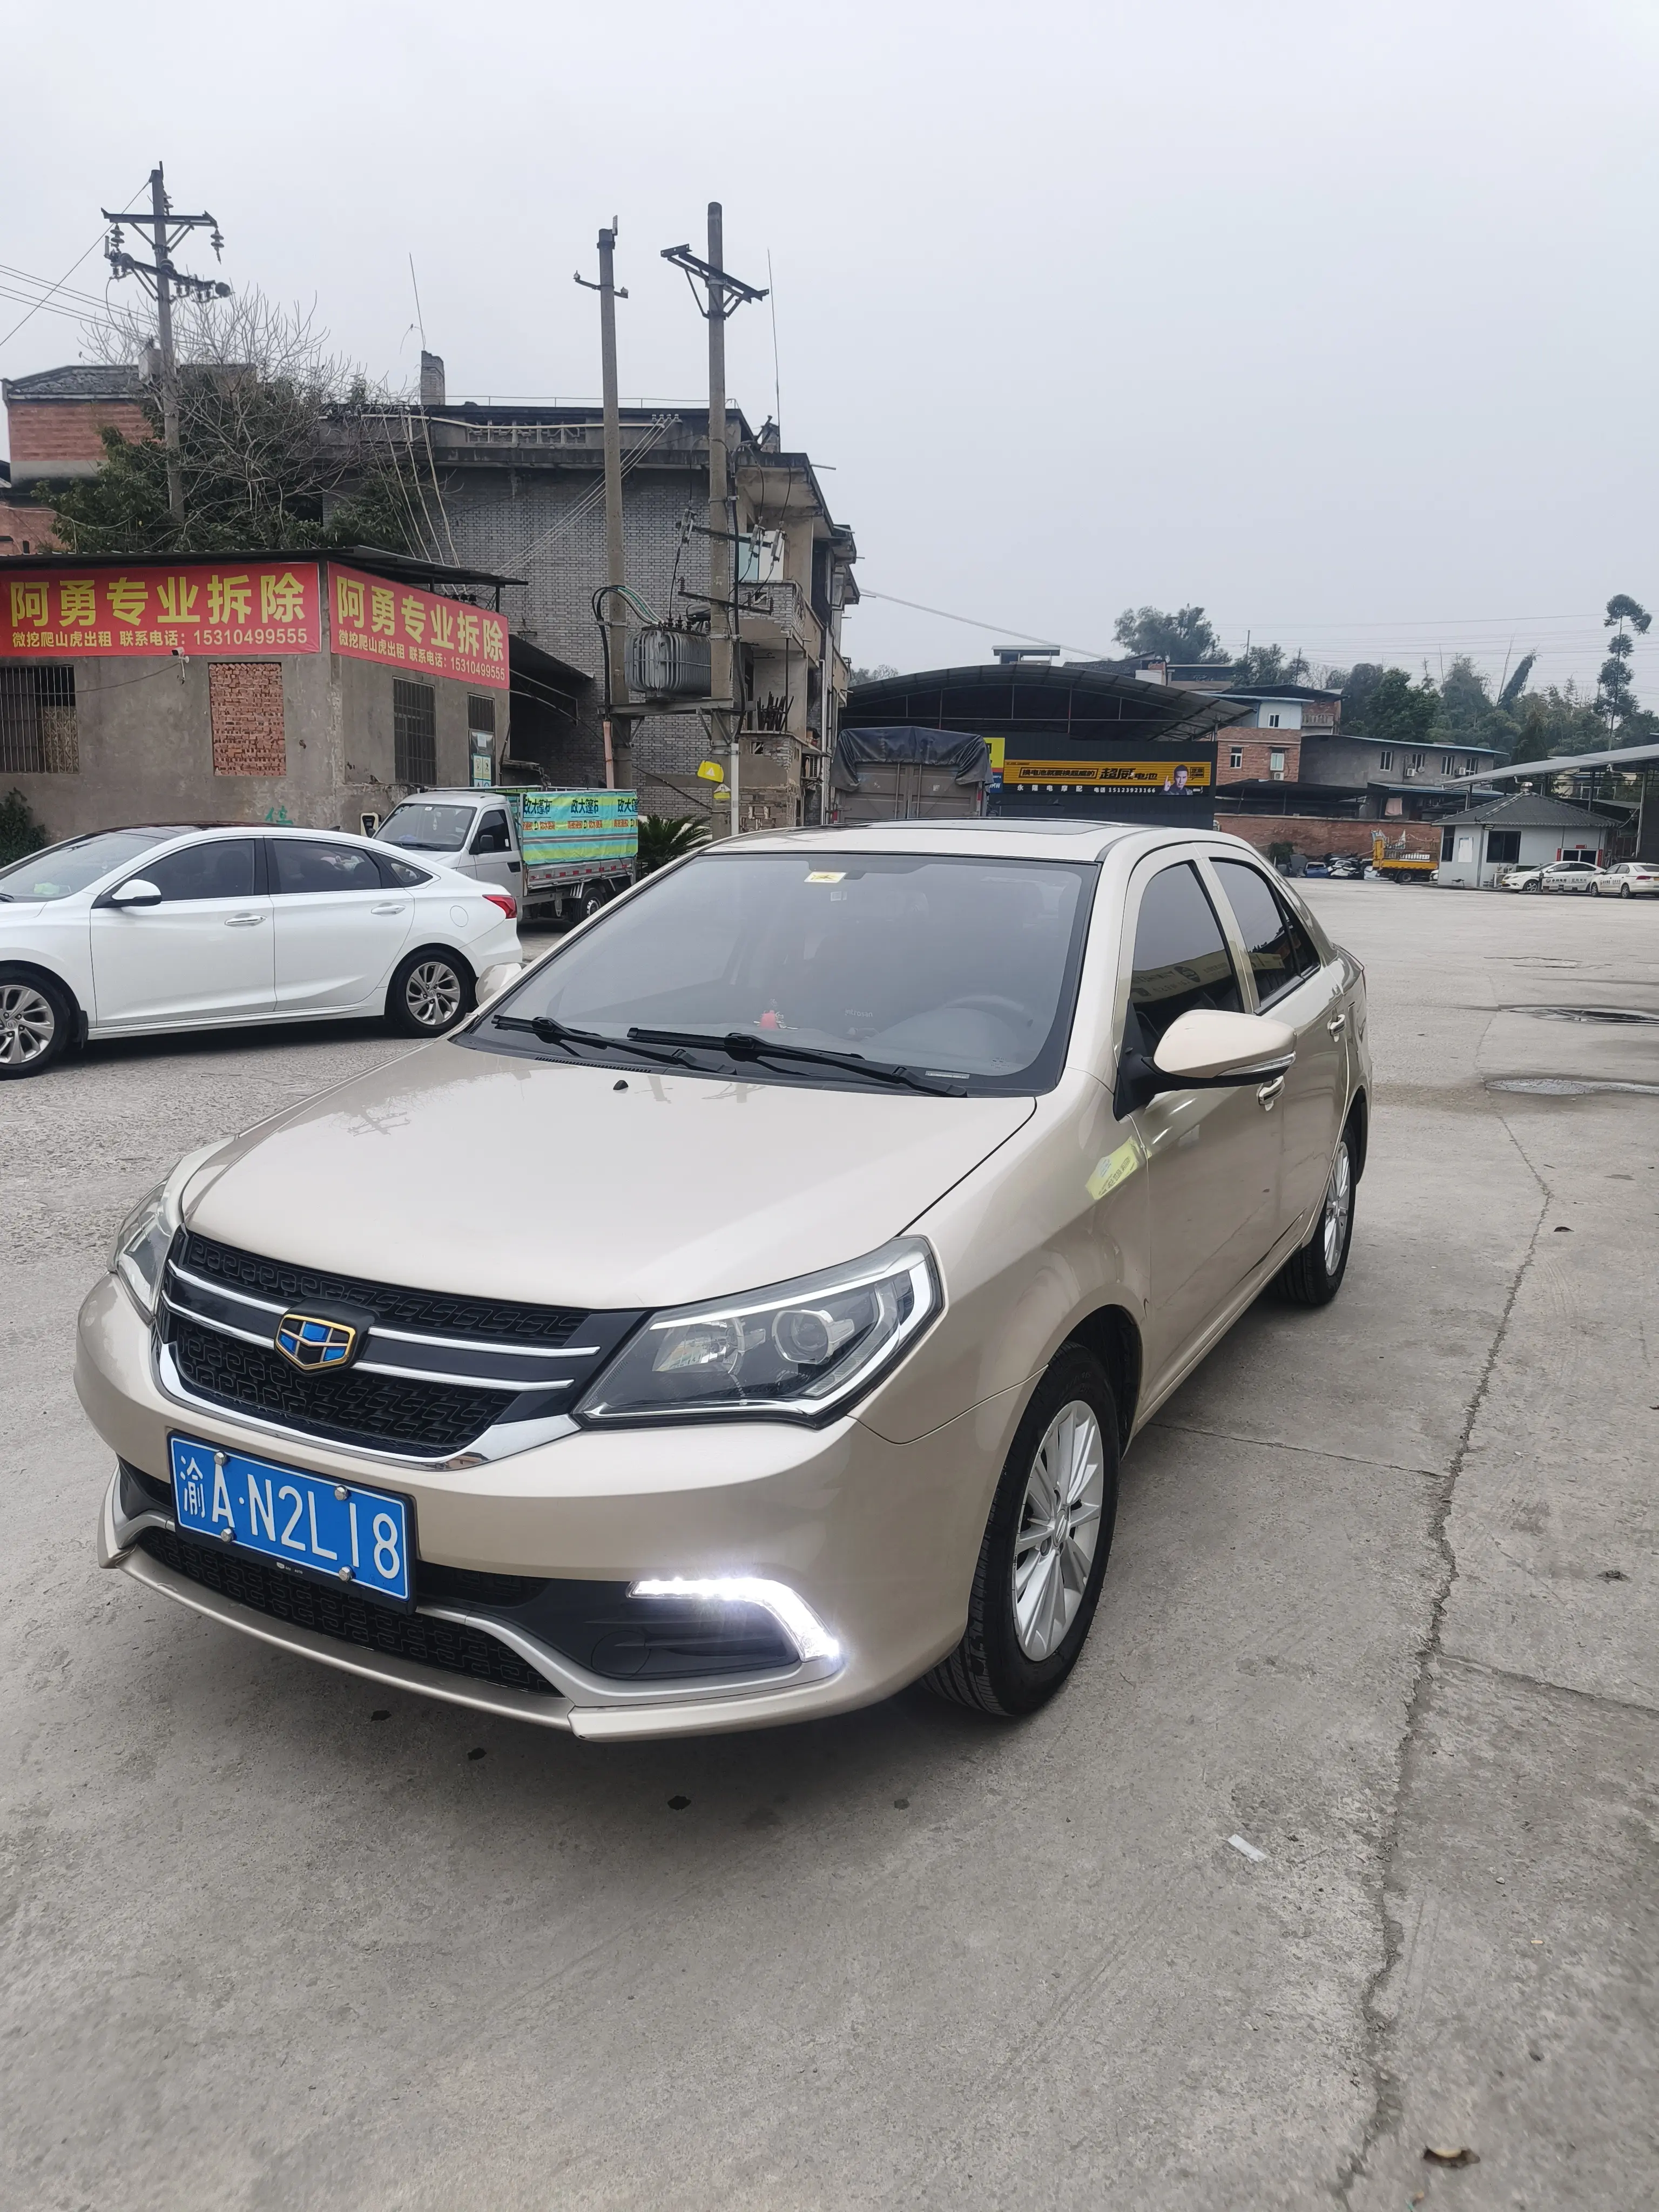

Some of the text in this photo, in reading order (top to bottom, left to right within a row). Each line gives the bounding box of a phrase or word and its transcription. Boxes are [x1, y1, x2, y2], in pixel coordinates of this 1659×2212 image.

[11, 572, 306, 627] 阿勇专业拆除
[337, 576, 504, 662] 阿勇专业拆除
[13, 631, 112, 648] 微挖爬山虎出租
[339, 629, 406, 659] 微挖爬山虎出租
[180, 1455, 400, 1579] 渝A·N2L18
